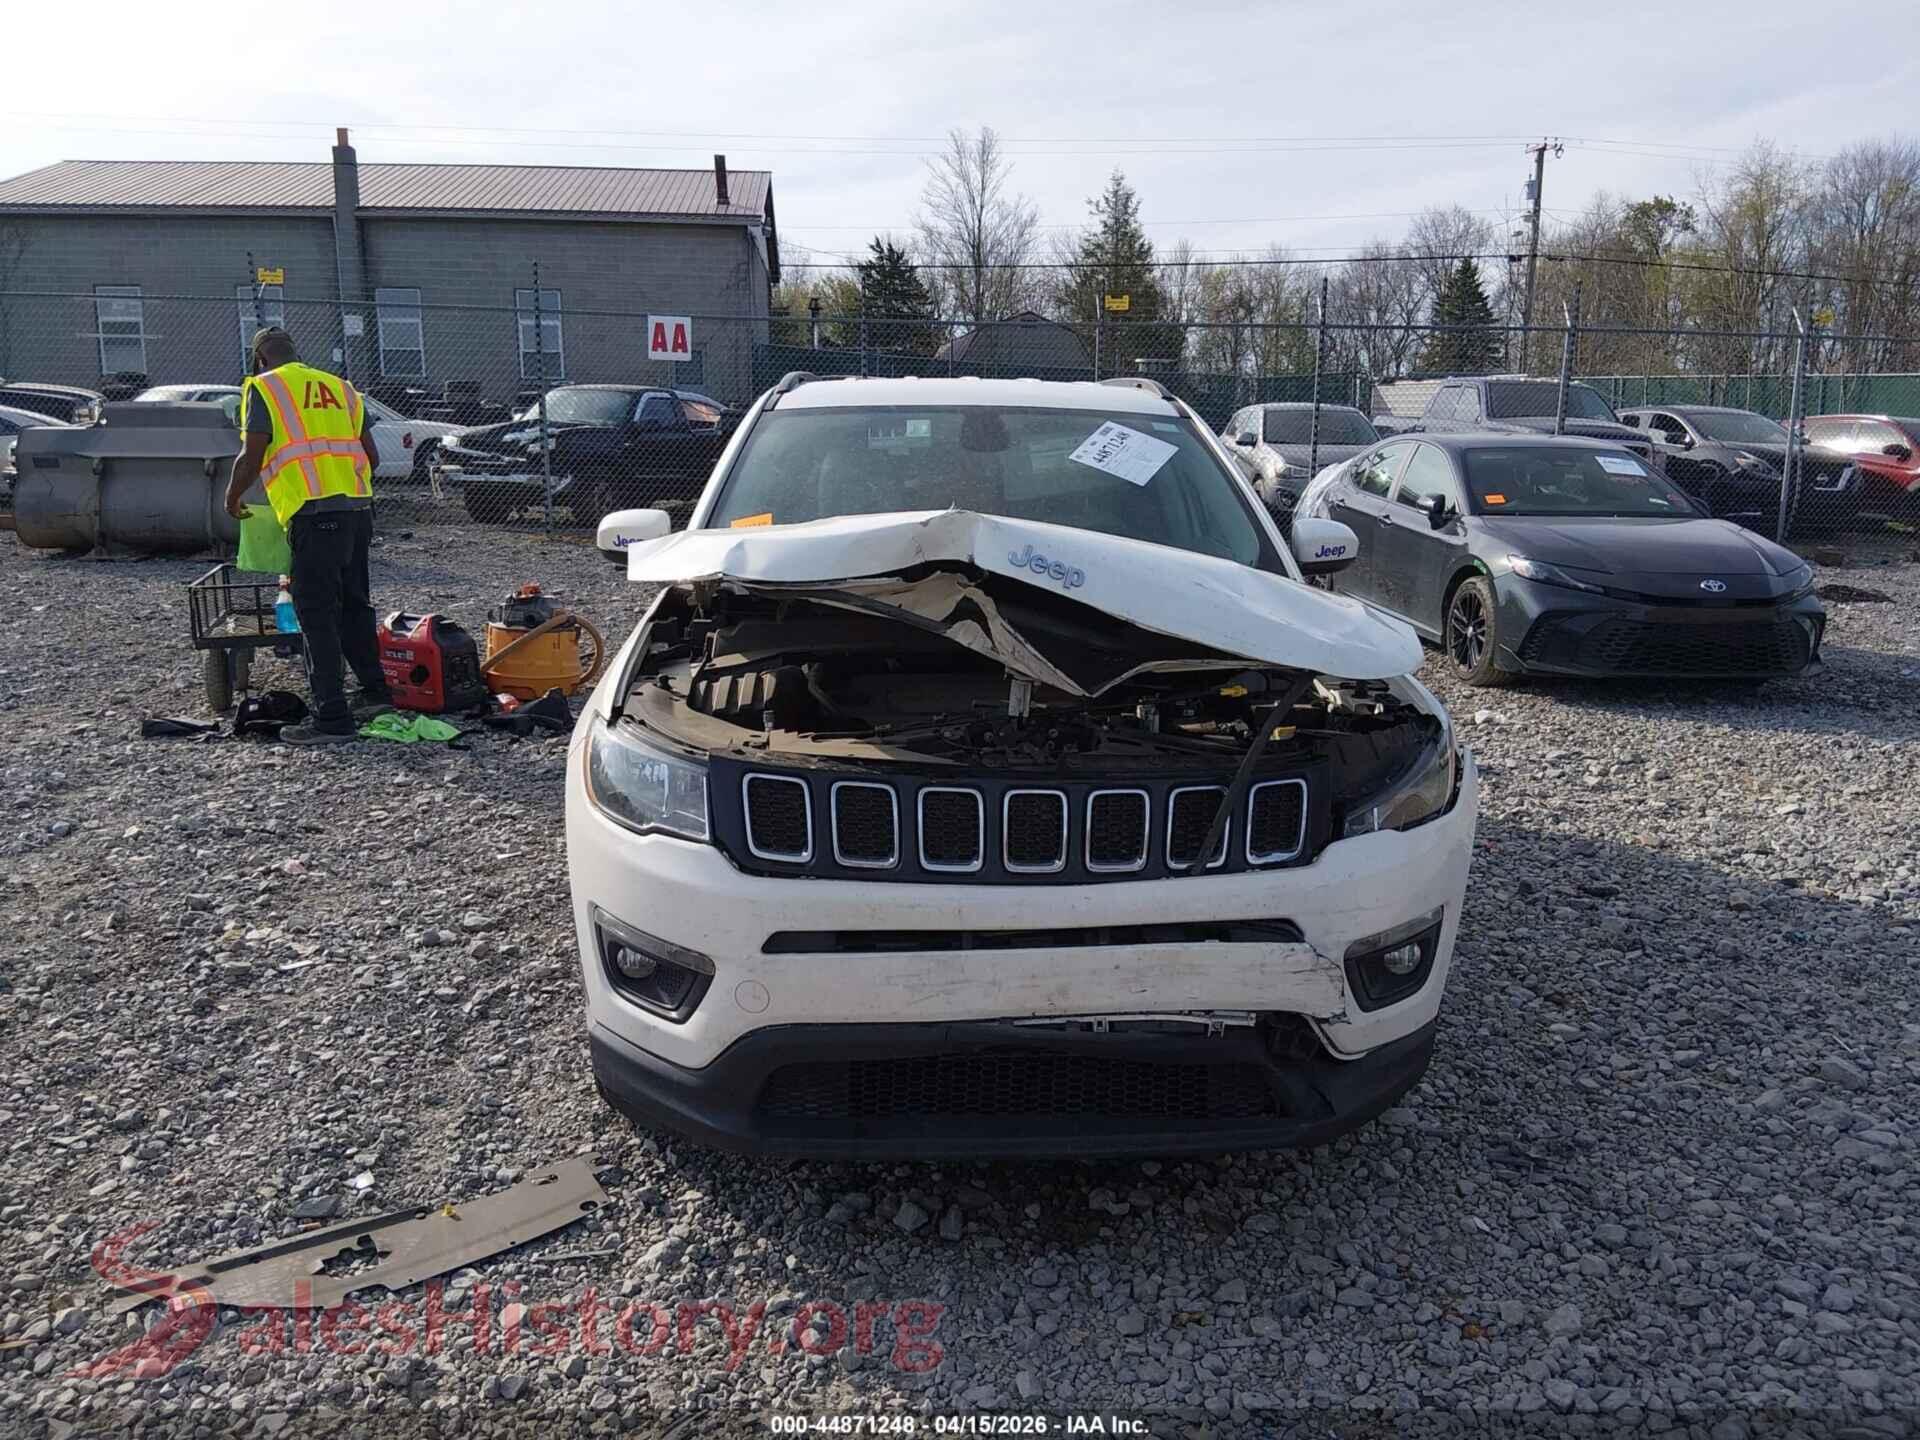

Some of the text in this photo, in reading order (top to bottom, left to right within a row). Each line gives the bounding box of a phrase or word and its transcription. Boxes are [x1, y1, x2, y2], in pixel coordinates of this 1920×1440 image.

[651, 321, 689, 354] AA
[612, 534, 645, 547] Jee
[1314, 544, 1346, 558] Jeep
[1007, 544, 1086, 590] Jeep
